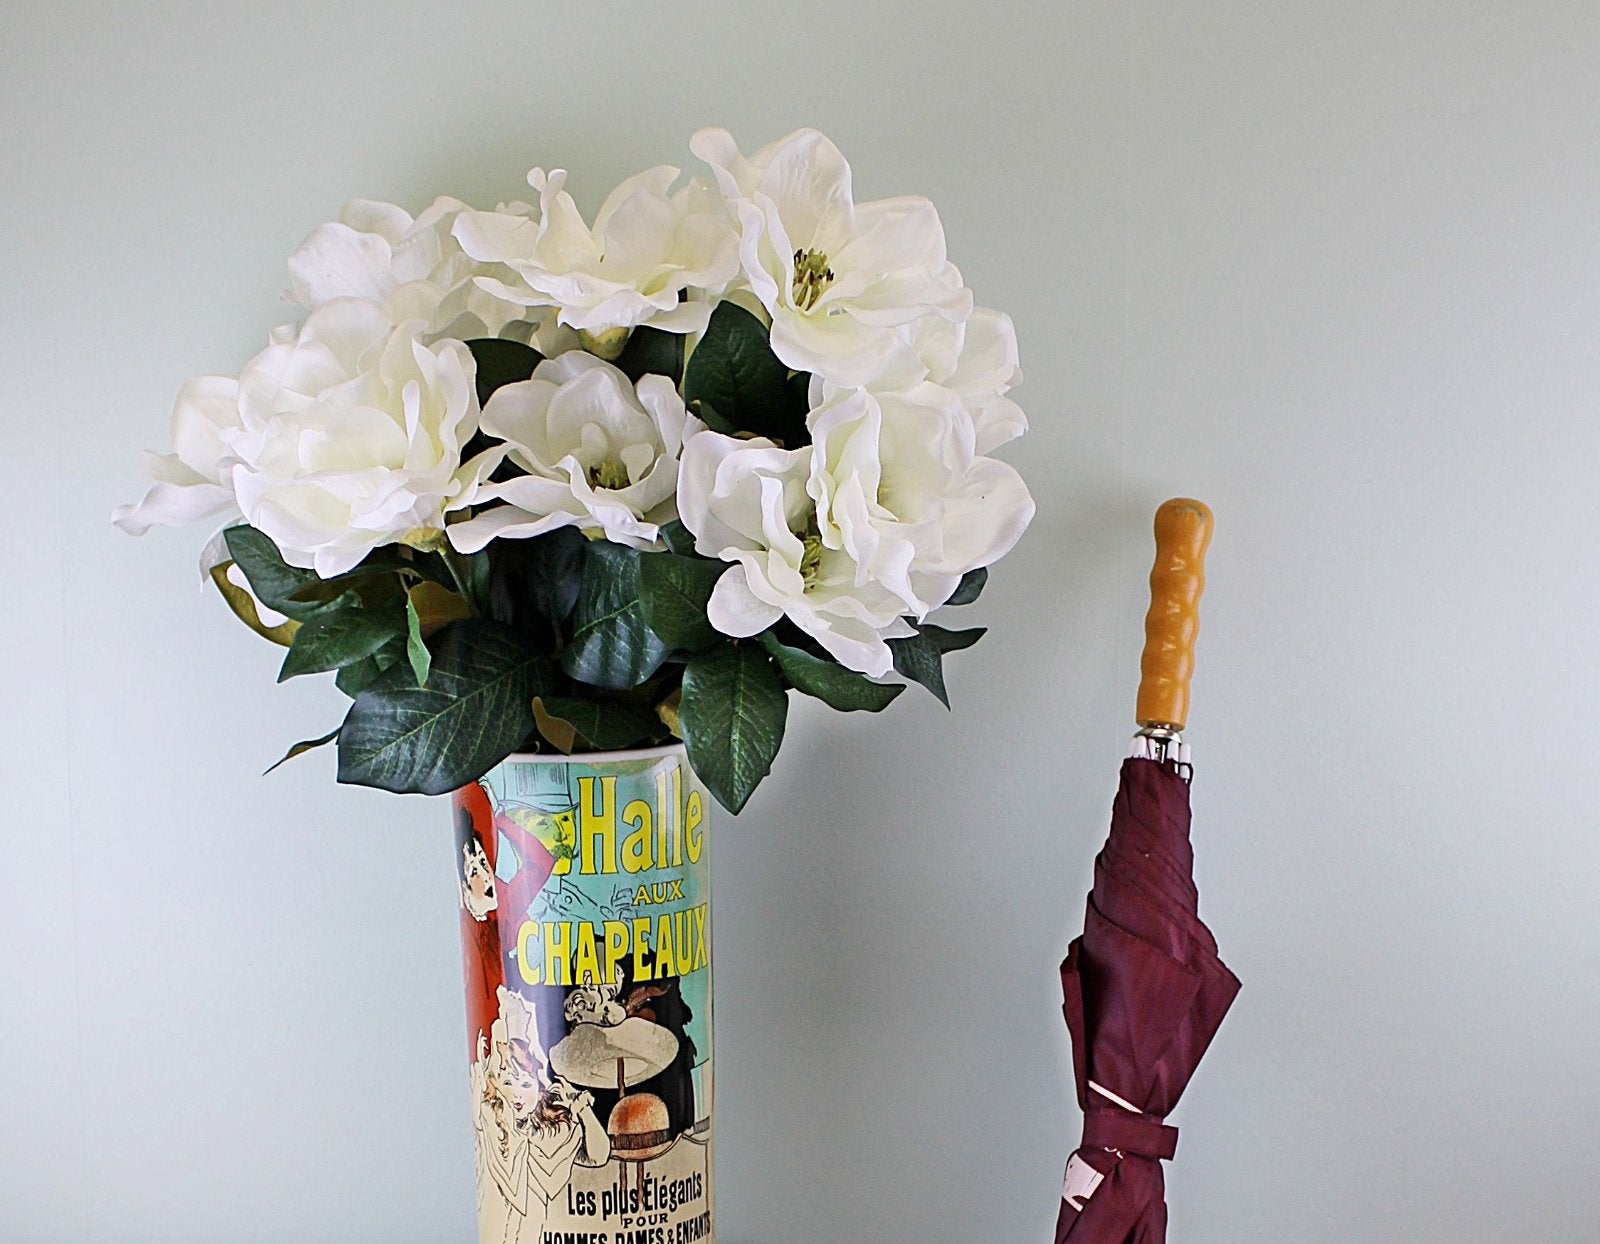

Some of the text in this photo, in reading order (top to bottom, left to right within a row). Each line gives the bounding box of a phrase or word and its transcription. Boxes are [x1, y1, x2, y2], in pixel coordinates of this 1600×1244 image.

[577, 765, 702, 875] Halle
[632, 879, 685, 906] AUX
[516, 902, 709, 986] CHAPEAUX
[567, 1170, 702, 1221] Les plus Élégants
[622, 1212, 669, 1229] POUR
